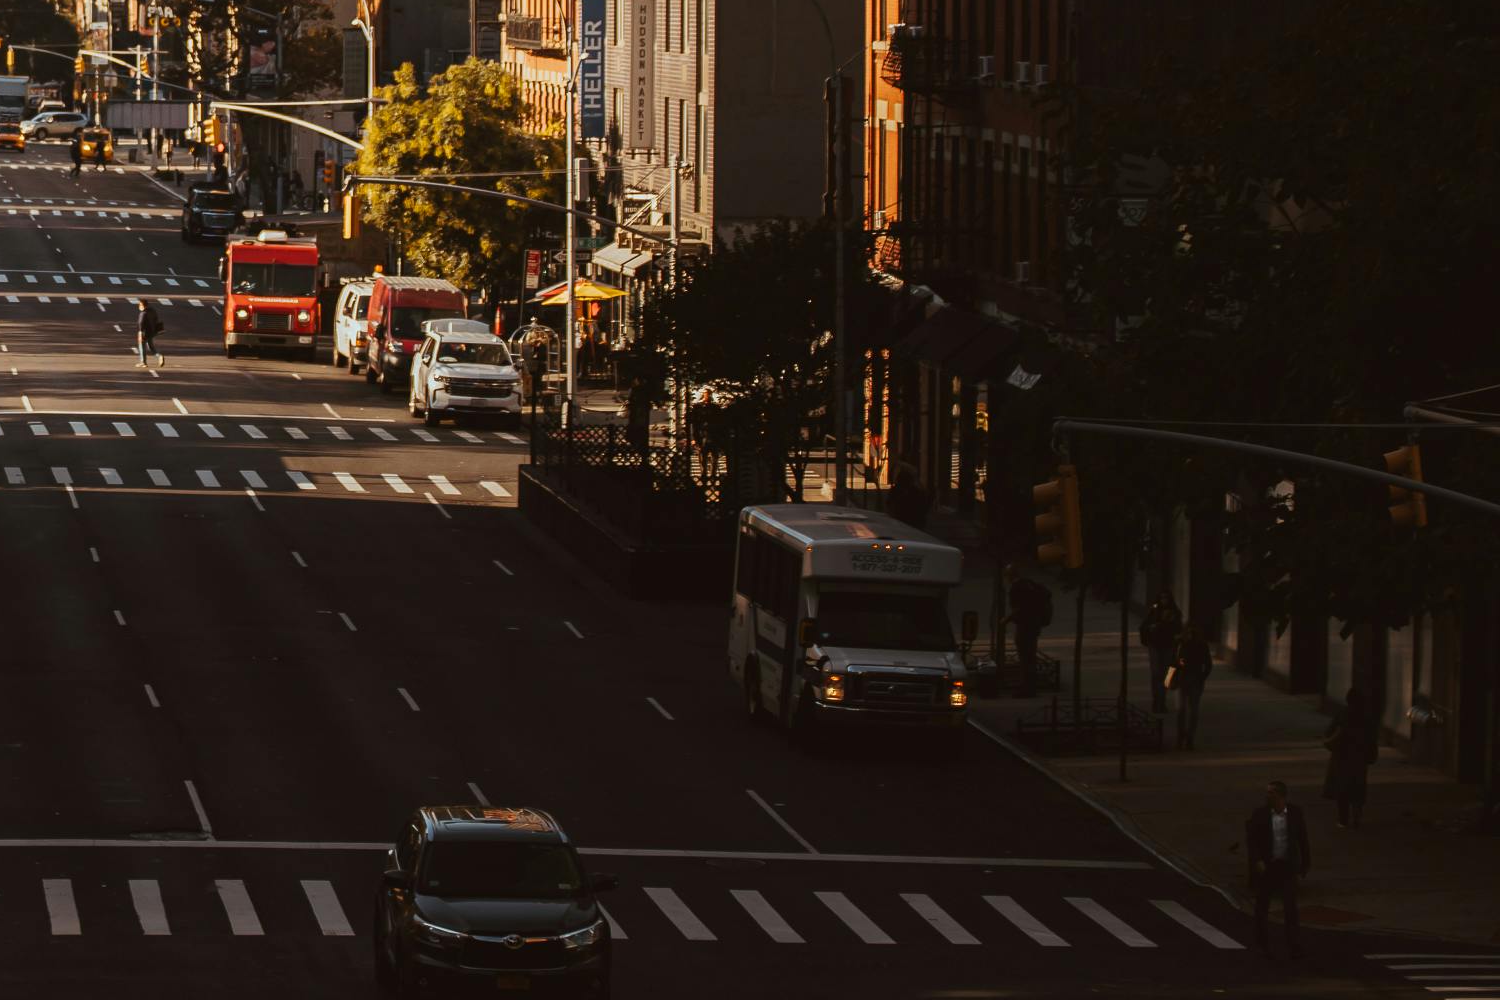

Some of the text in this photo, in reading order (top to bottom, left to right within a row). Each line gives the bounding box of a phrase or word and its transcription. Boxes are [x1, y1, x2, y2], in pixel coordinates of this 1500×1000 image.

[584, 20, 603, 109] HELLER
[637, 4, 647, 141] HUDSON MARKET
